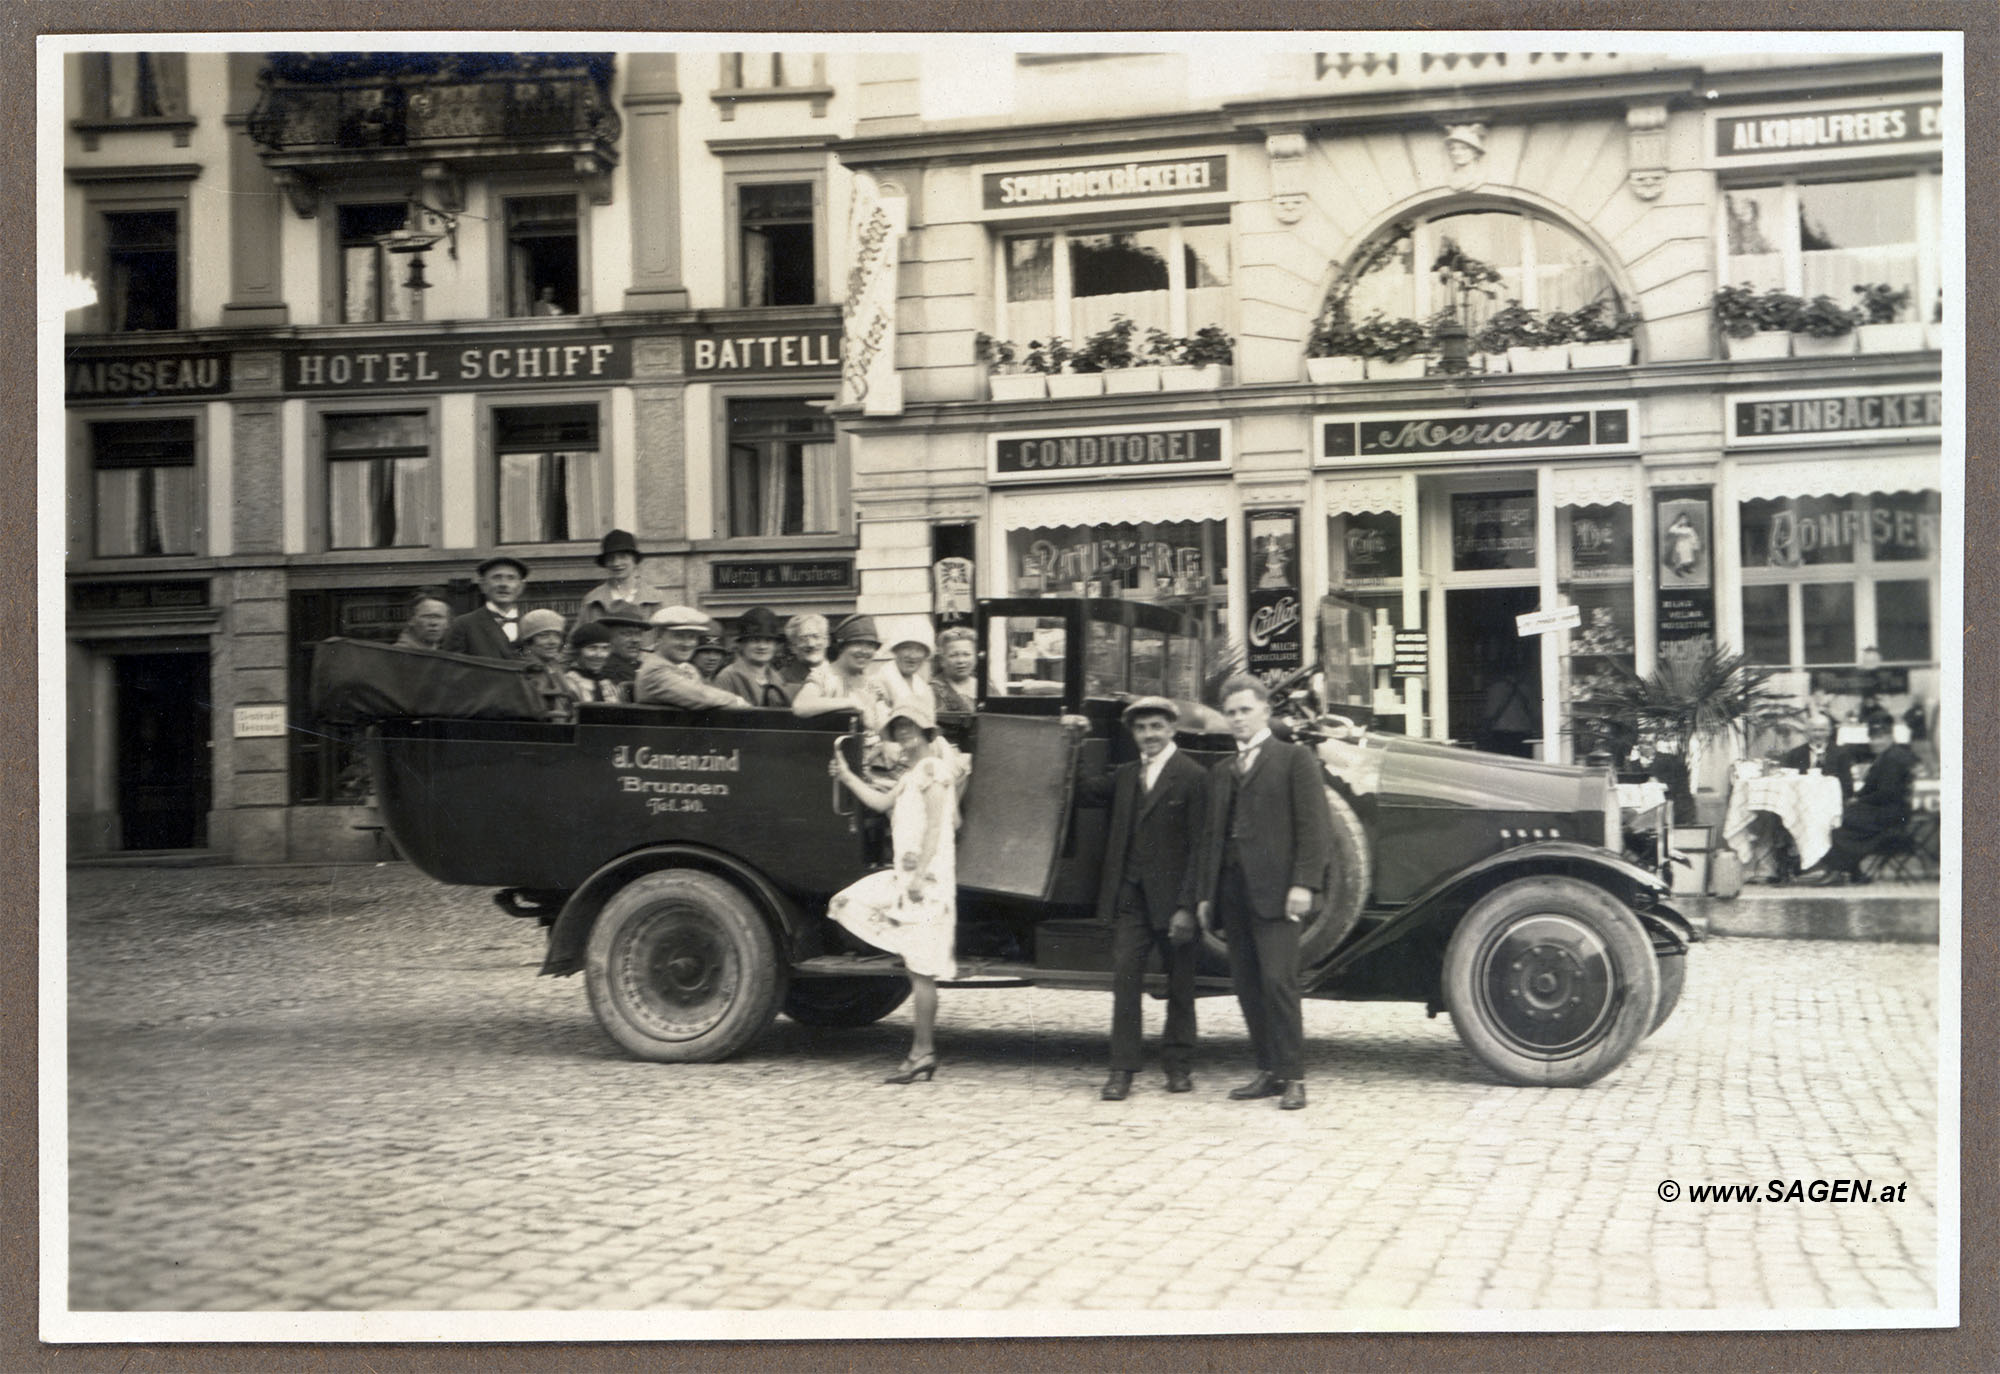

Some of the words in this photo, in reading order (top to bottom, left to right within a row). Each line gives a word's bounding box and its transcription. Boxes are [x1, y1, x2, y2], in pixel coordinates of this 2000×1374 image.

[1733, 109, 1907, 150] ALKOHOLFREIES
[65, 358, 220, 394] AISSEAU
[298, 352, 440, 385] HOTEL
[460, 344, 614, 379] SCHIFF
[1019, 431, 1197, 468] CONDITOREI
[1378, 417, 1576, 448] Mercur
[635, 746, 740, 771] Camenzind
[617, 776, 729, 795] Brunnen
